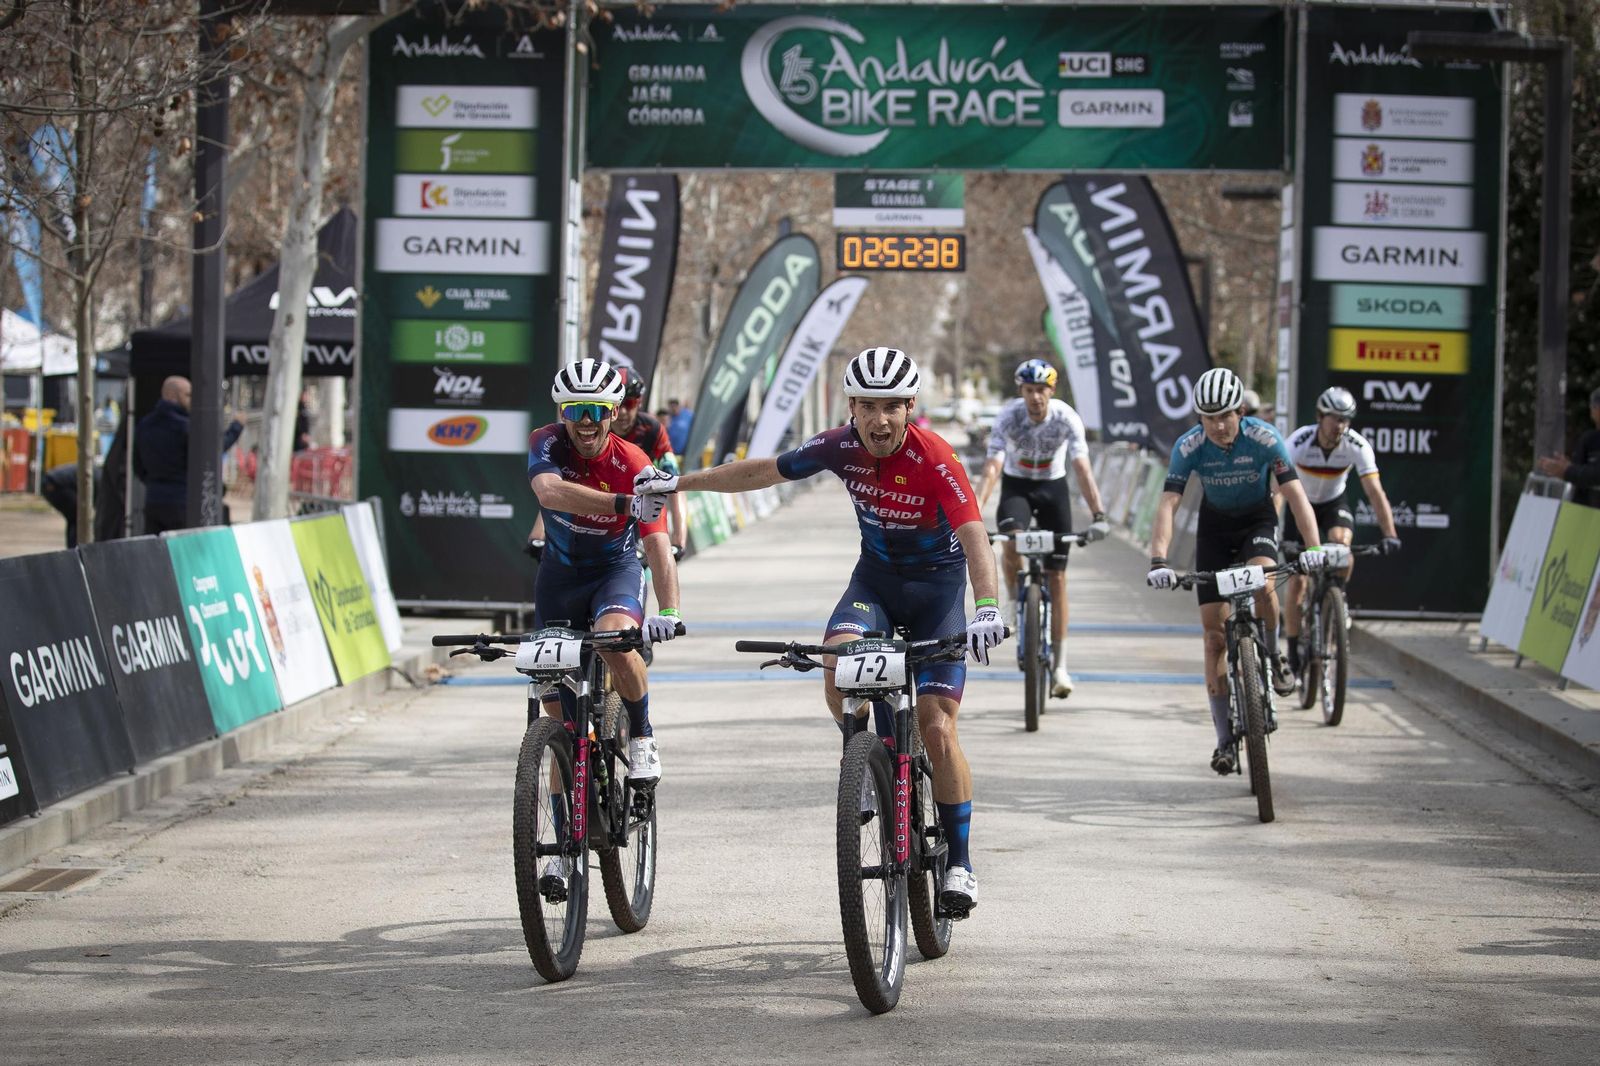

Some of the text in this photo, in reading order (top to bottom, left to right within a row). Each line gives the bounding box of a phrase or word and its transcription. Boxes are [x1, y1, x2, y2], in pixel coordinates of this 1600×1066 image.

[613, 24, 681, 42] Andalucía
[392, 33, 484, 59] Andalucía
[820, 34, 1042, 89] Andalucía
[1069, 57, 1106, 73] UCI
[628, 64, 706, 82] GRANADA
[628, 84, 672, 102] JAÉN
[628, 106, 705, 125] CÓRDOBA
[822, 88, 1045, 126] BIKE RACE
[1071, 101, 1152, 116] GARMIN
[864, 179, 919, 191] STAGE
[403, 235, 521, 256] GARMIN
[1341, 244, 1460, 267] GARMIN
[1357, 340, 1440, 362] PIRELLI
[434, 374, 486, 394] NDL
[775, 335, 823, 412] GOBIK
[434, 423, 478, 440] KH7
[946, 475, 968, 504] KENDA
[870, 505, 922, 519] KENDA
[1025, 532, 1044, 549] 9-1
[1229, 569, 1253, 588] 1-2
[112, 614, 190, 675] GARMIN
[533, 640, 563, 663] 7-1
[10, 635, 105, 708] GARMIN
[854, 655, 888, 682] 7-2
[575, 761, 585, 832] MANITOU
[896, 778, 908, 853] MANITOU
